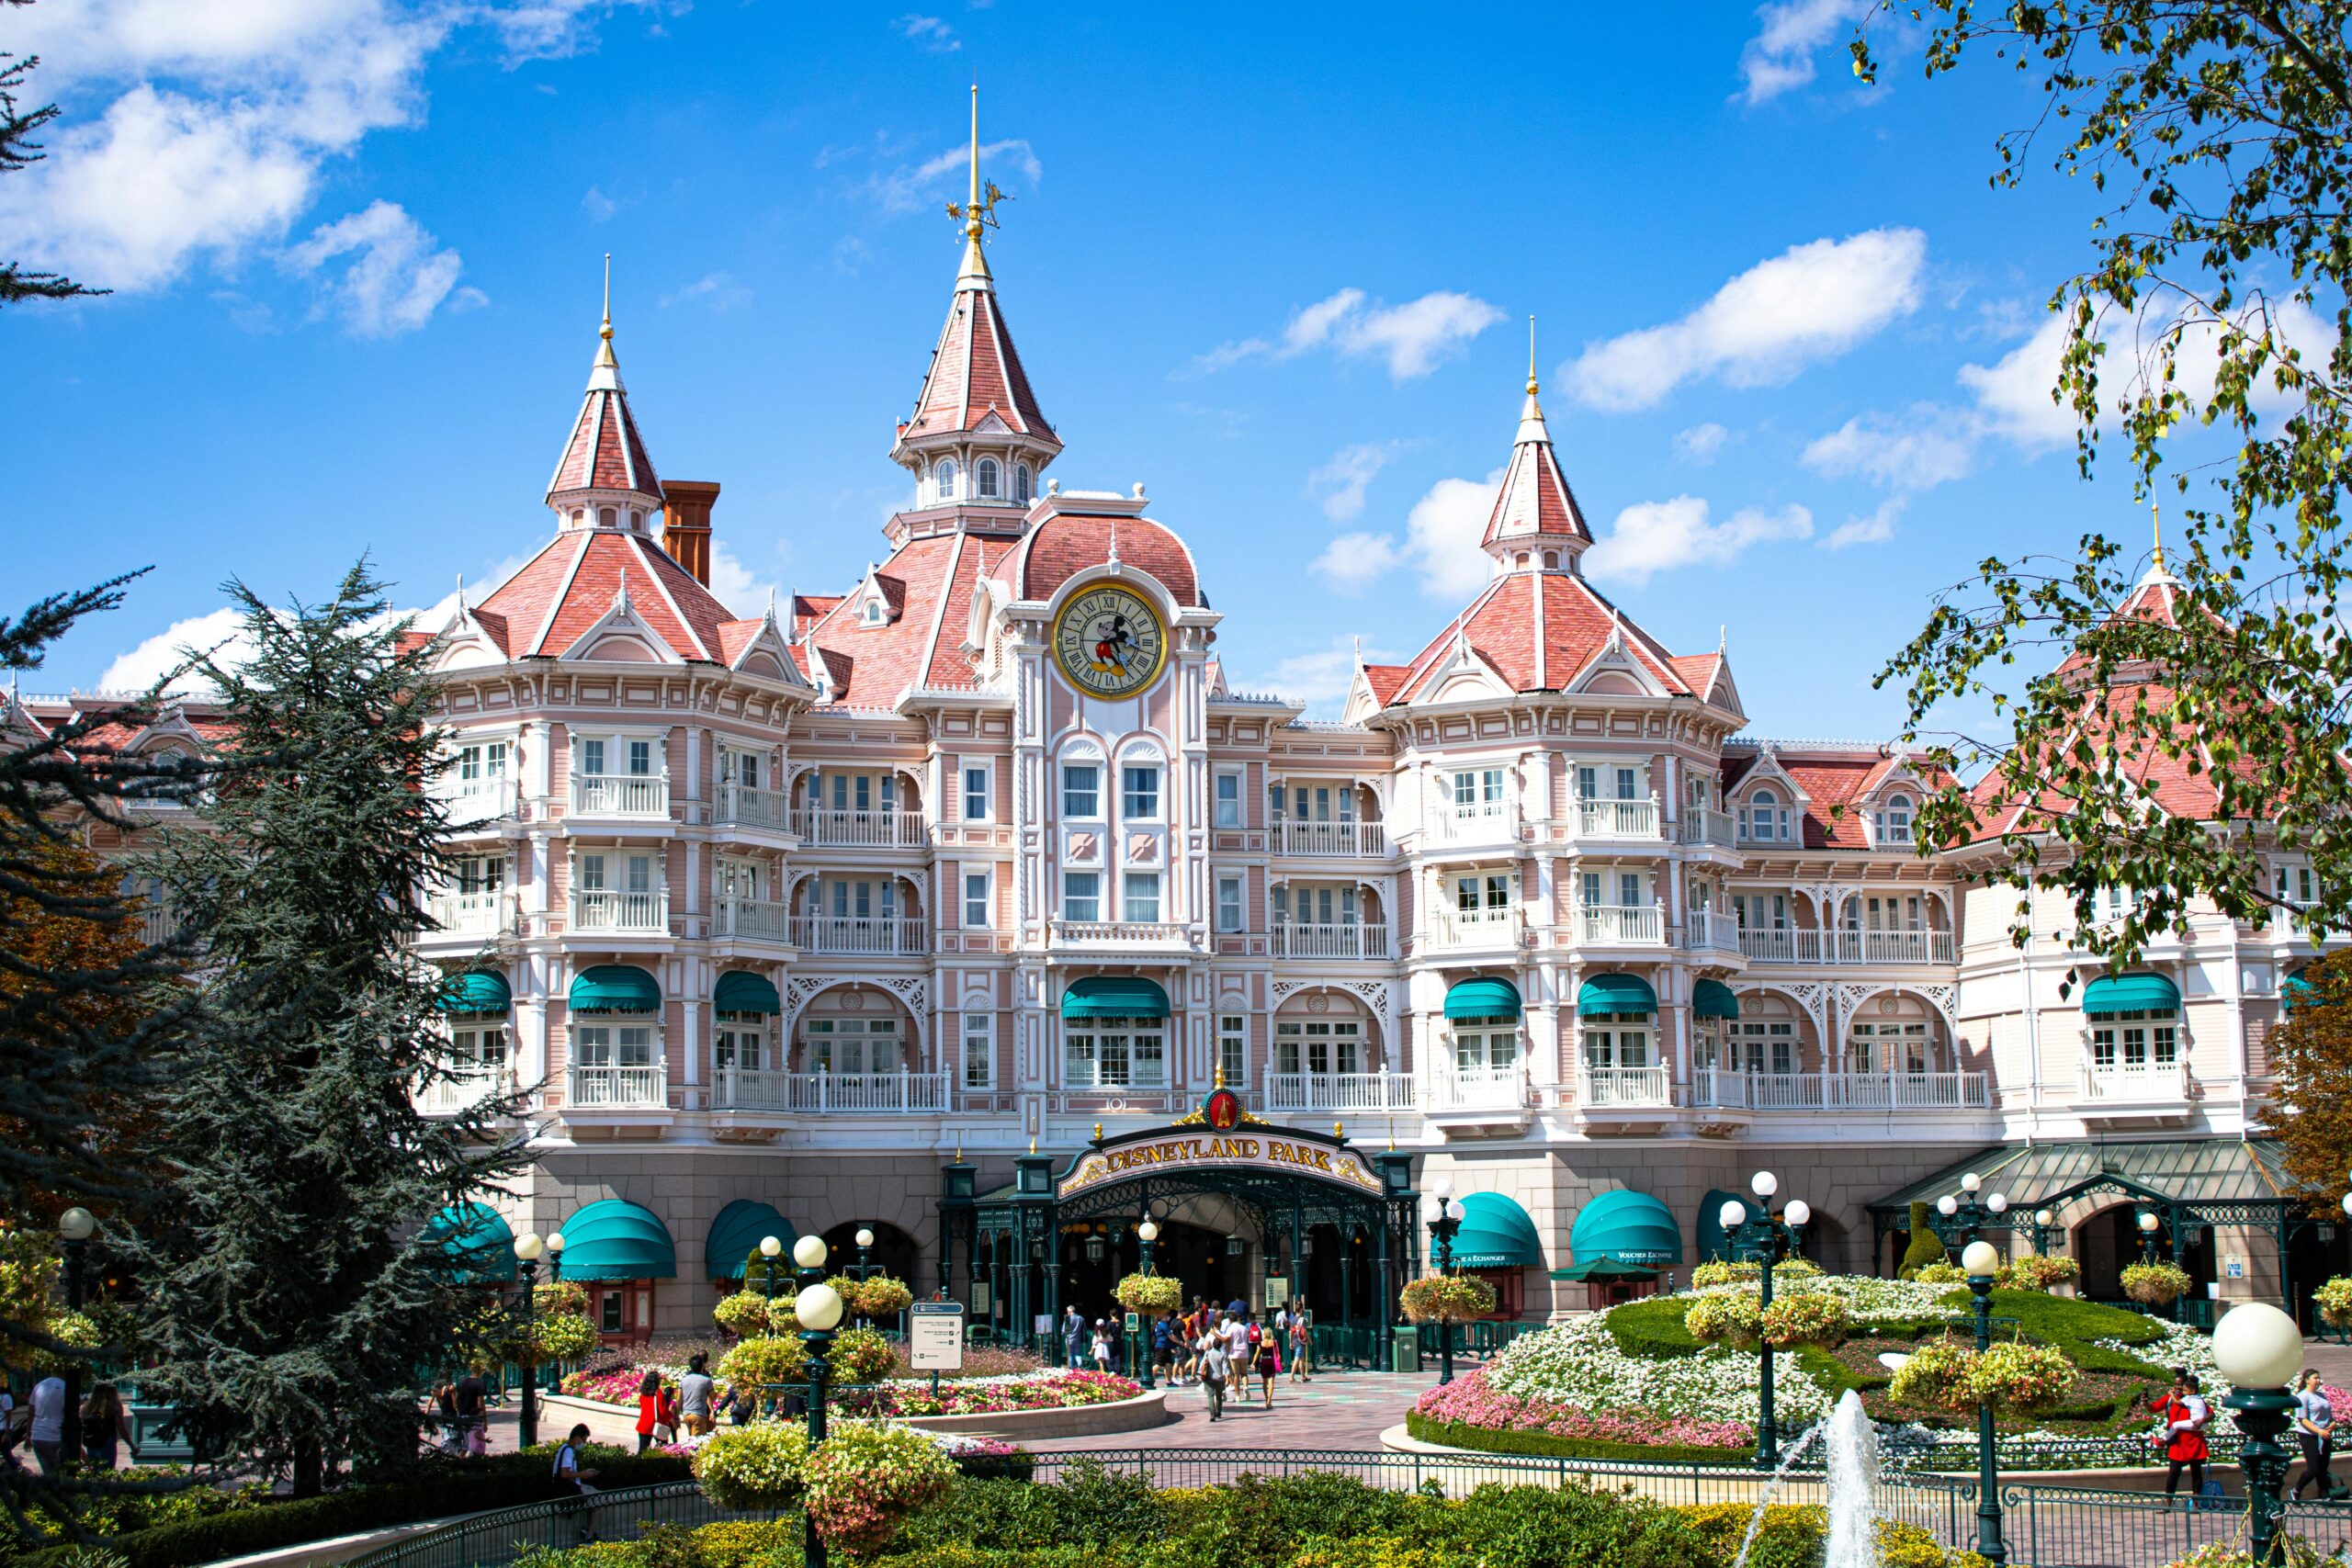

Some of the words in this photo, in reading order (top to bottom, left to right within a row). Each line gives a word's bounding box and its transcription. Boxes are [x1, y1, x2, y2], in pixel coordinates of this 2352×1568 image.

[1084, 601, 1096, 614] XI
[1103, 597, 1114, 608] XII
[1125, 604, 1132, 613] I
[1070, 616, 1081, 626] X
[1137, 619, 1148, 627] II
[1066, 637, 1076, 645] IX
[1069, 652, 1082, 668] VIII
[1137, 656, 1149, 669] IIII
[1105, 675, 1114, 686] VI
[1105, 1138, 1260, 1174] DISNEYLAND
[1268, 1140, 1331, 1171] PARK
[1114, 1234, 1120, 1243] 7
